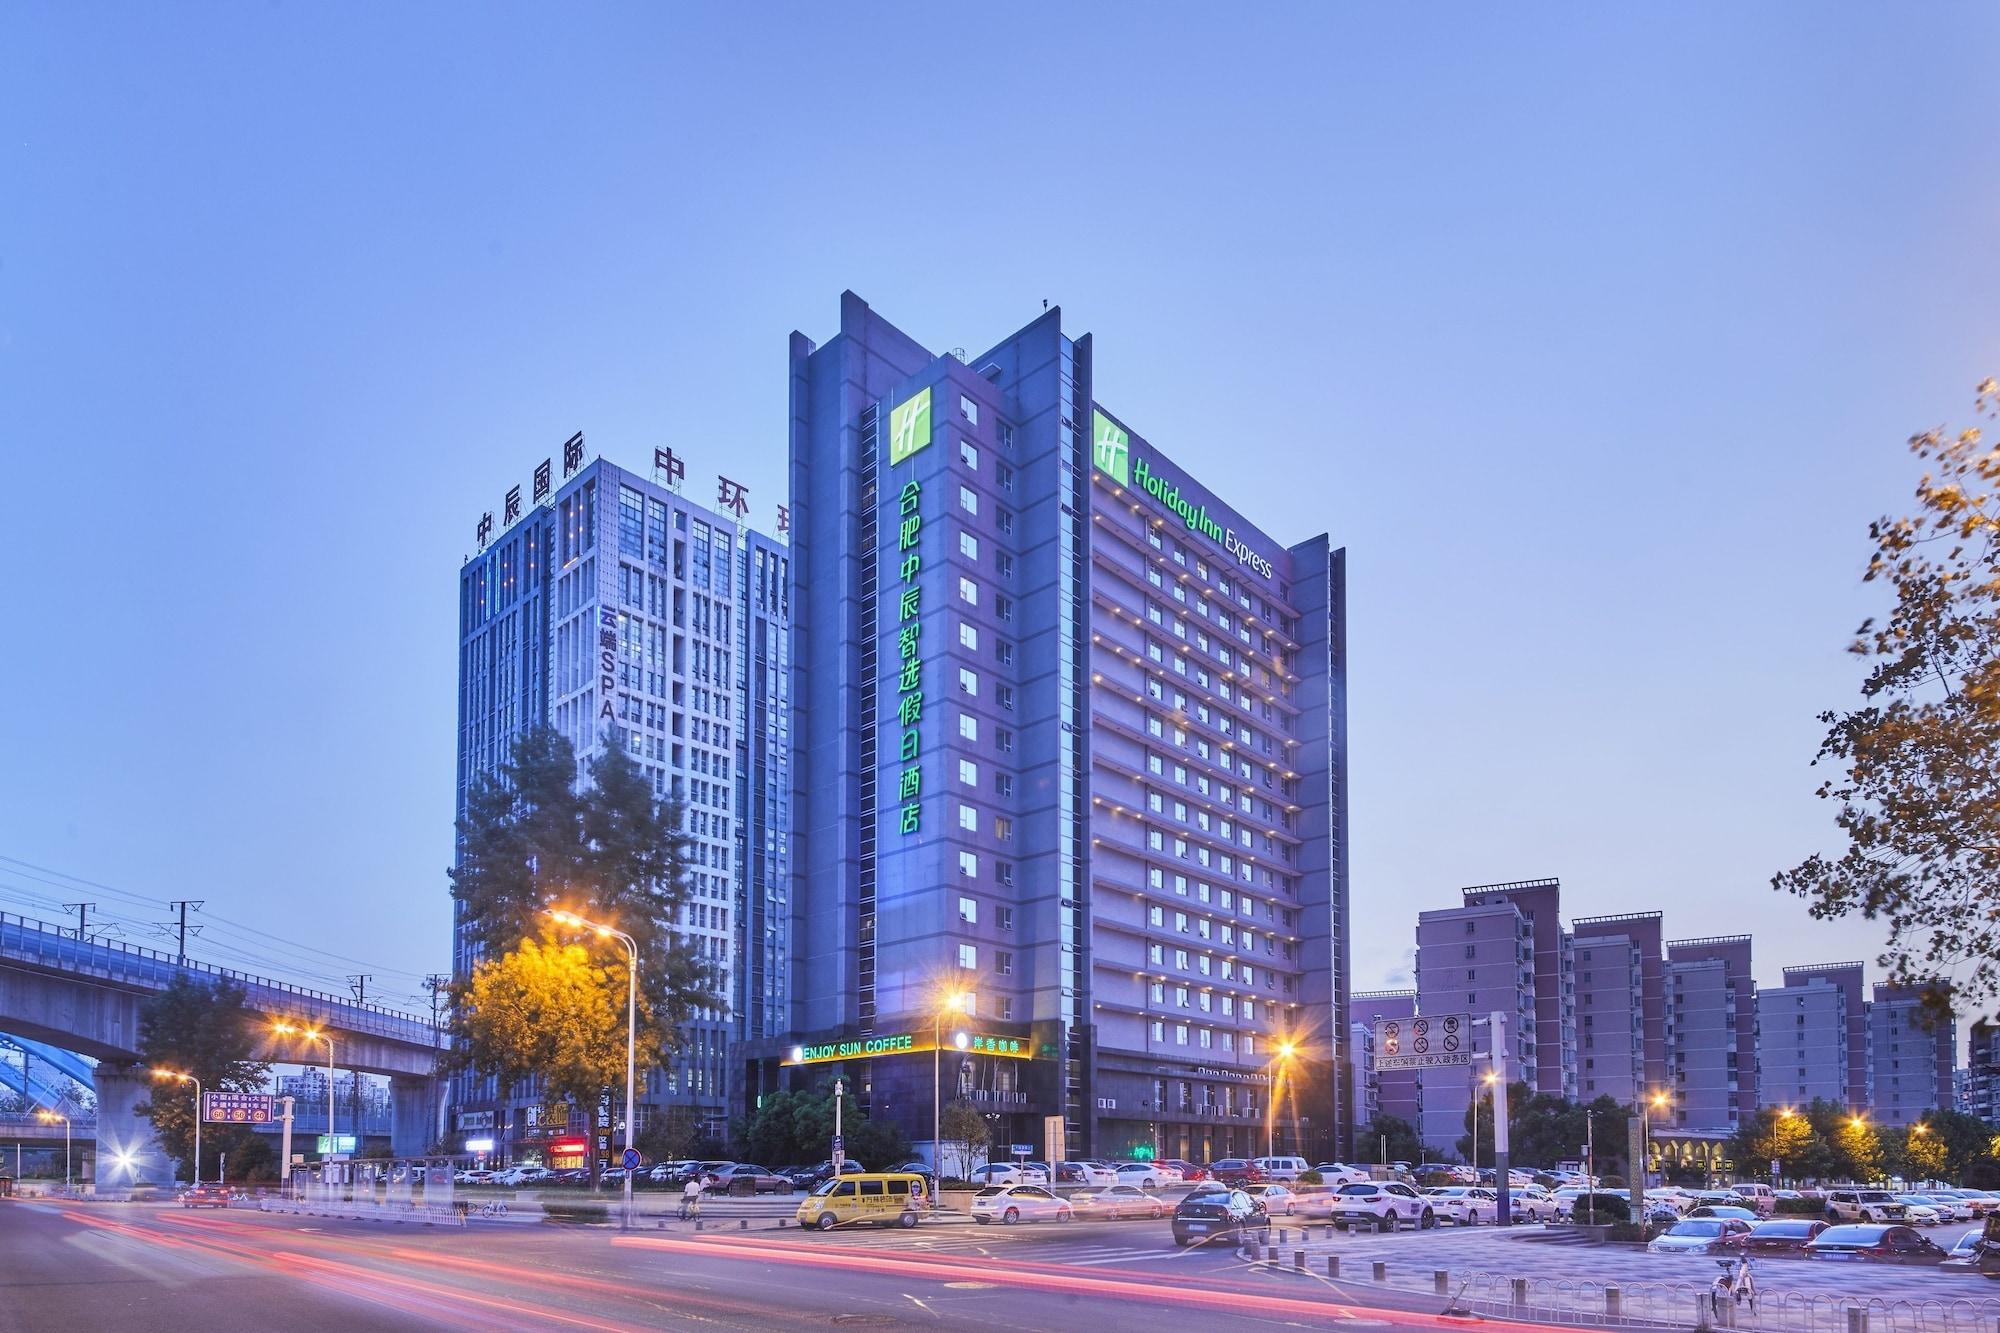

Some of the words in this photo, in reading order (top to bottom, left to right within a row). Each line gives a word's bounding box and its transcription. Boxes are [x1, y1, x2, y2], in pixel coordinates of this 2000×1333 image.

[477, 430, 583, 547] 中辰国际
[1134, 457, 1198, 530] Holiday
[1199, 505, 1223, 543] Inn
[1225, 528, 1272, 579] Express
[898, 480, 921, 835] 合肥中辰智选假日酒店
[803, 1044, 836, 1060] ENJOY
[839, 1042, 861, 1056] SUN
[866, 1036, 912, 1054] COFFEE
